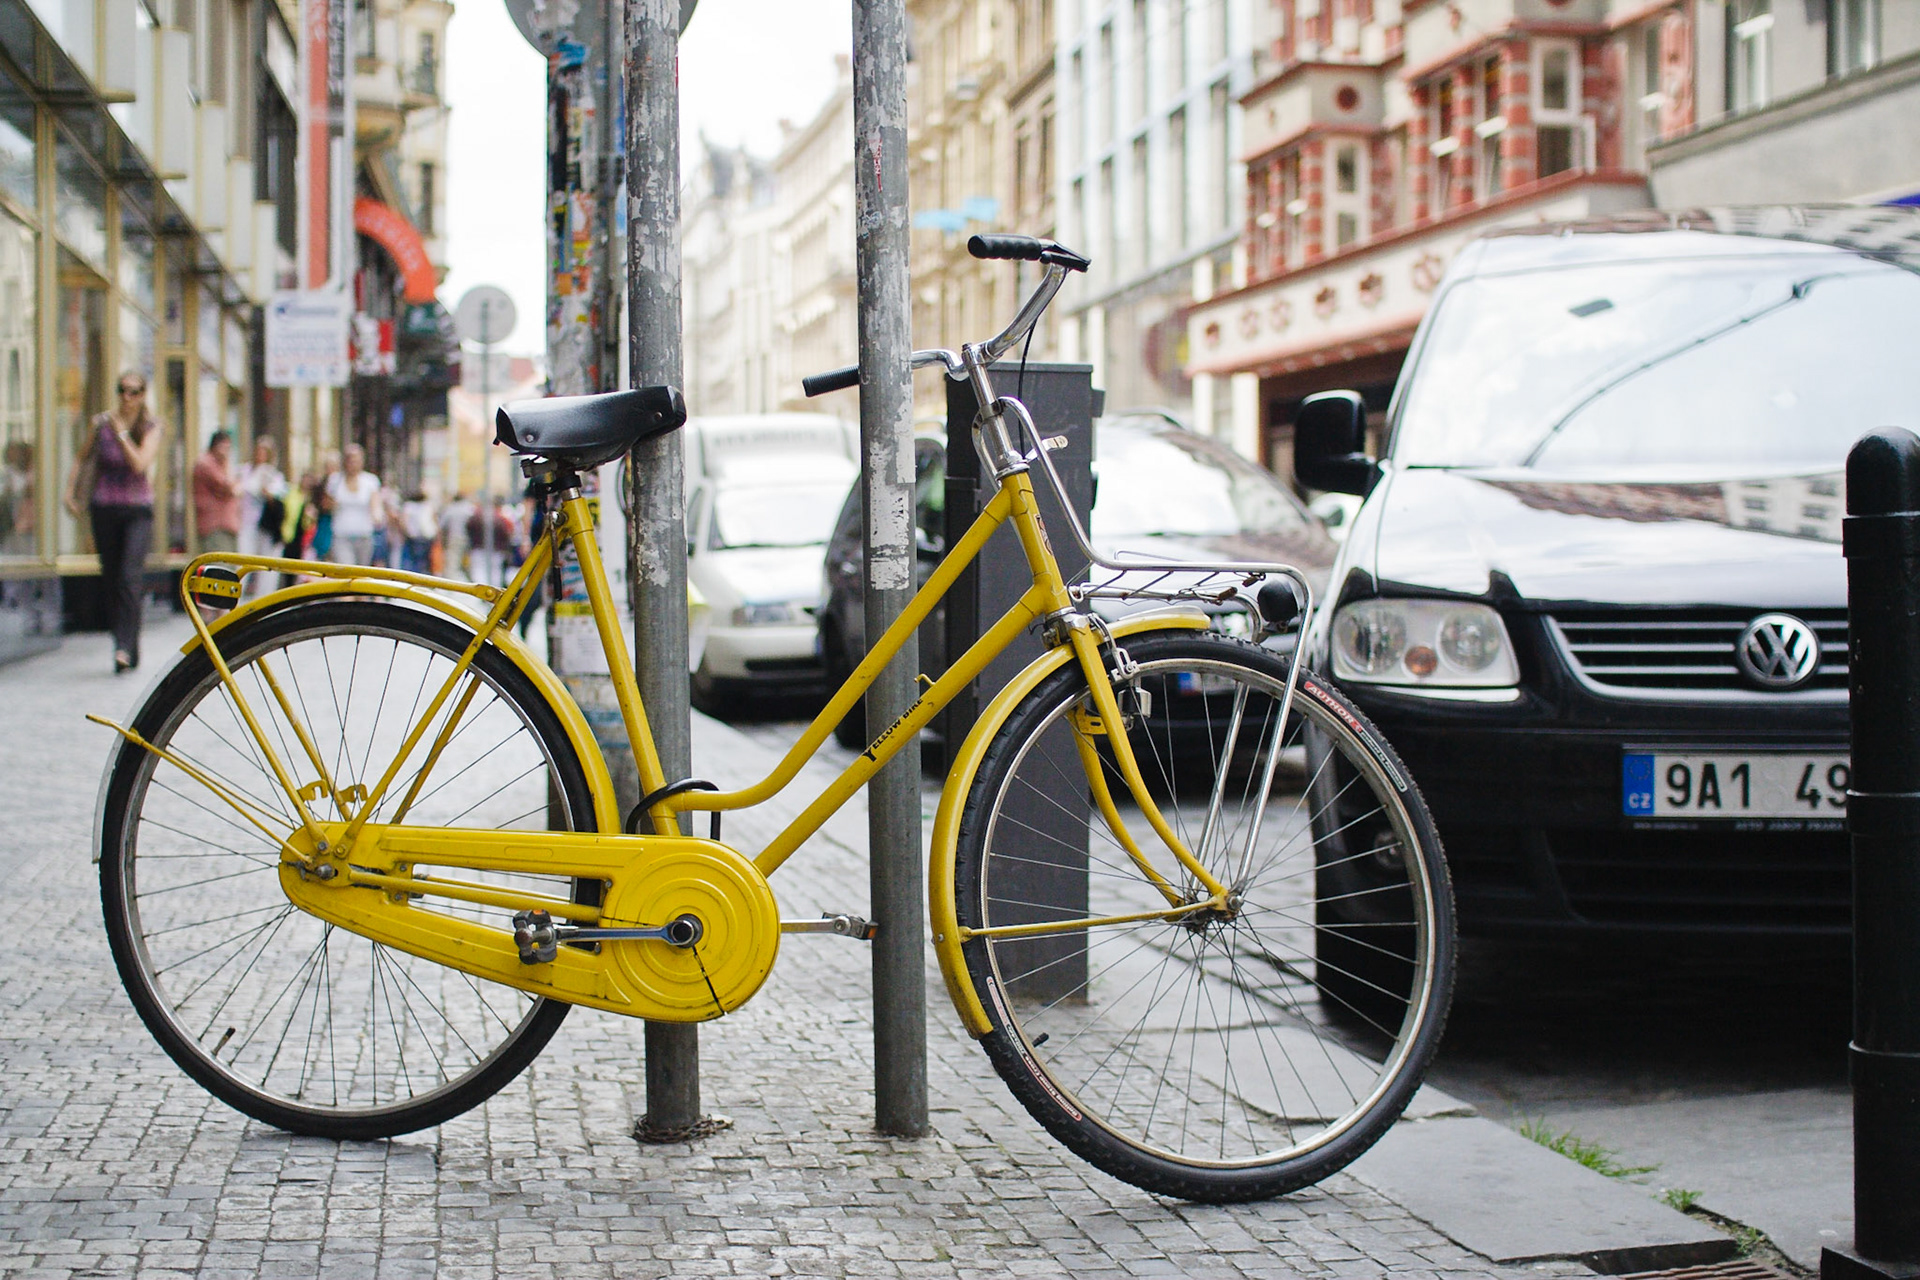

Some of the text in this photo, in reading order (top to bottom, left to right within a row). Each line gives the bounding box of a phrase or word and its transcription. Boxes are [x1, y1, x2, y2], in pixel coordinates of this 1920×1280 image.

[1308, 685, 1355, 725] AUTHOR
[862, 718, 902, 762] YELLOW
[1628, 792, 1652, 809] CZ
[1666, 762, 1750, 809] 9A1
